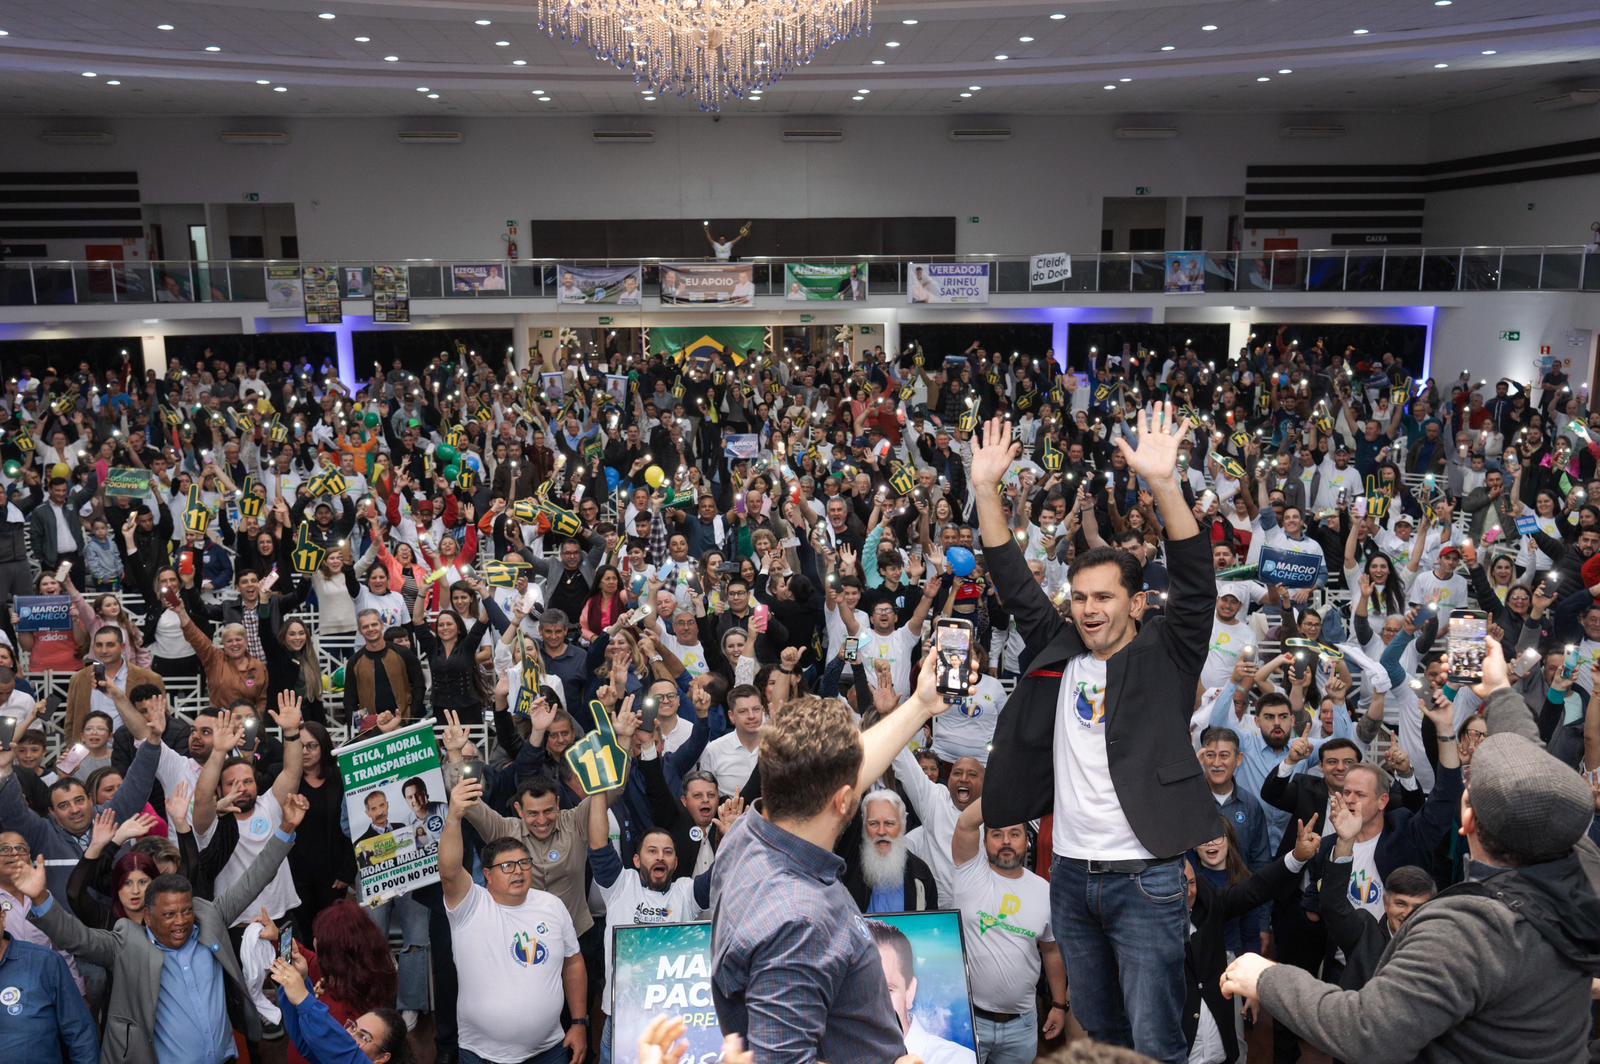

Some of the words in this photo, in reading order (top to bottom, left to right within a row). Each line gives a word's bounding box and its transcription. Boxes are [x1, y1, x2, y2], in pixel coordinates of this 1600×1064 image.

[930, 266, 982, 274] VEREADOR
[1032, 271, 1044, 281] do
[1048, 268, 1068, 280] Doce
[685, 278, 699, 286] EU
[702, 278, 734, 286] APOIO
[943, 278, 976, 286] IRINEU
[940, 287, 980, 296] SANTOS
[915, 357, 922, 365] 11
[715, 374, 724, 384] 11
[989, 374, 996, 383] 11
[675, 386, 684, 396] 11
[771, 384, 779, 392] 11
[902, 388, 912, 398] 11
[1097, 387, 1108, 398] 11
[1052, 390, 1060, 400] 11
[1393, 390, 1406, 402] 11
[1018, 400, 1030, 408] 11
[477, 407, 491, 420] 11
[240, 414, 250, 428] 11
[962, 416, 974, 428] 11
[1320, 418, 1330, 432] 11
[271, 427, 283, 439] 11
[447, 432, 459, 445] 11
[1235, 433, 1250, 444] 11
[18, 436, 32, 448] 11
[1046, 454, 1058, 468] 11
[1228, 460, 1245, 476] 11
[325, 474, 344, 494] 11
[896, 474, 912, 492] 11
[243, 498, 260, 516] 11
[1368, 498, 1382, 515] 11
[188, 508, 208, 530] 11
[558, 514, 578, 533] 11
[298, 550, 318, 571] 11
[1276, 562, 1316, 574] MARCIO
[32, 606, 68, 614] MARCIO
[524, 668, 538, 694] 11
[352, 748, 384, 766] ÉTICA,
[386, 734, 422, 755] MORAL
[344, 774, 352, 785] E
[353, 746, 434, 782] TRANSPARÊNCIA
[578, 745, 618, 788] 11
[429, 818, 441, 830] 55
[361, 860, 394, 878] MOACIR
[396, 849, 426, 866] MARIA
[425, 842, 438, 854] 55
[362, 872, 389, 886] SUPLENTE
[390, 866, 412, 876] FEDERAL
[374, 884, 380, 893] O
[382, 876, 406, 890] POVO
[408, 870, 420, 880] NO
[422, 864, 439, 876] POD
[656, 954, 712, 980] MA
[644, 982, 714, 1010] PAC
